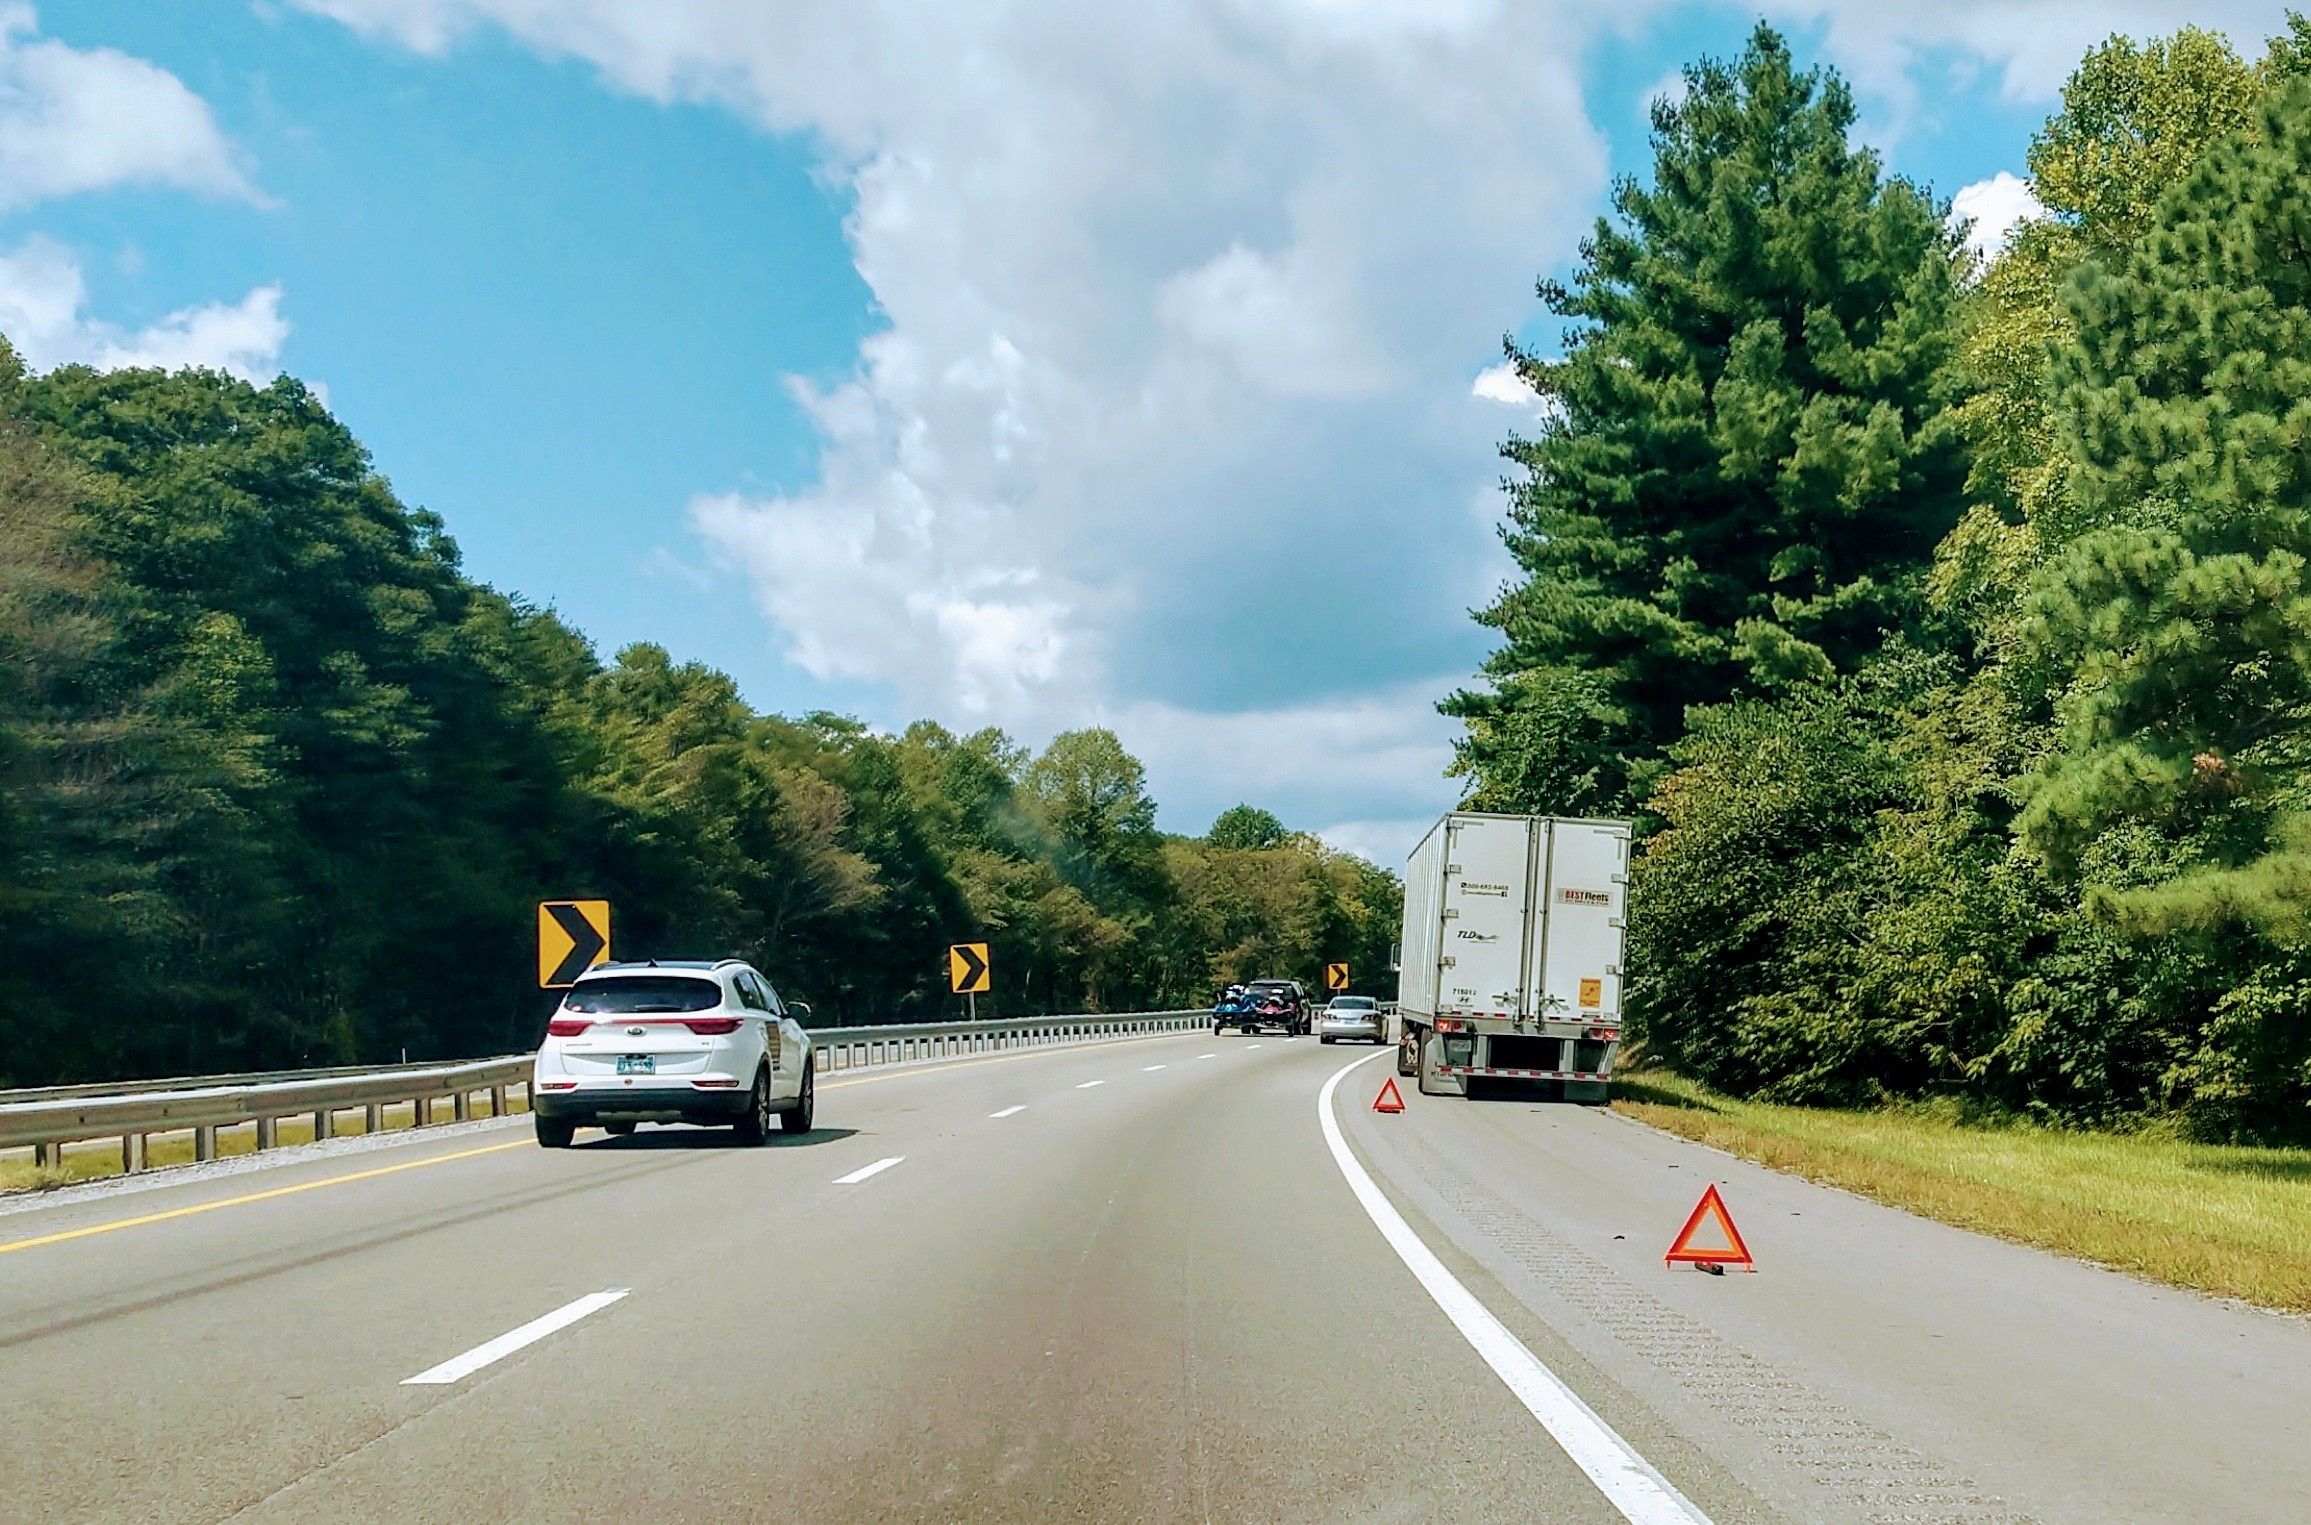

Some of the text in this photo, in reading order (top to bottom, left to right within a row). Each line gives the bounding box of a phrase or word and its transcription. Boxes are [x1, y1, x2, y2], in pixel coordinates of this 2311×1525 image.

[1565, 890, 1609, 902] BEST Fleets
[1457, 930, 1476, 939] TLD
